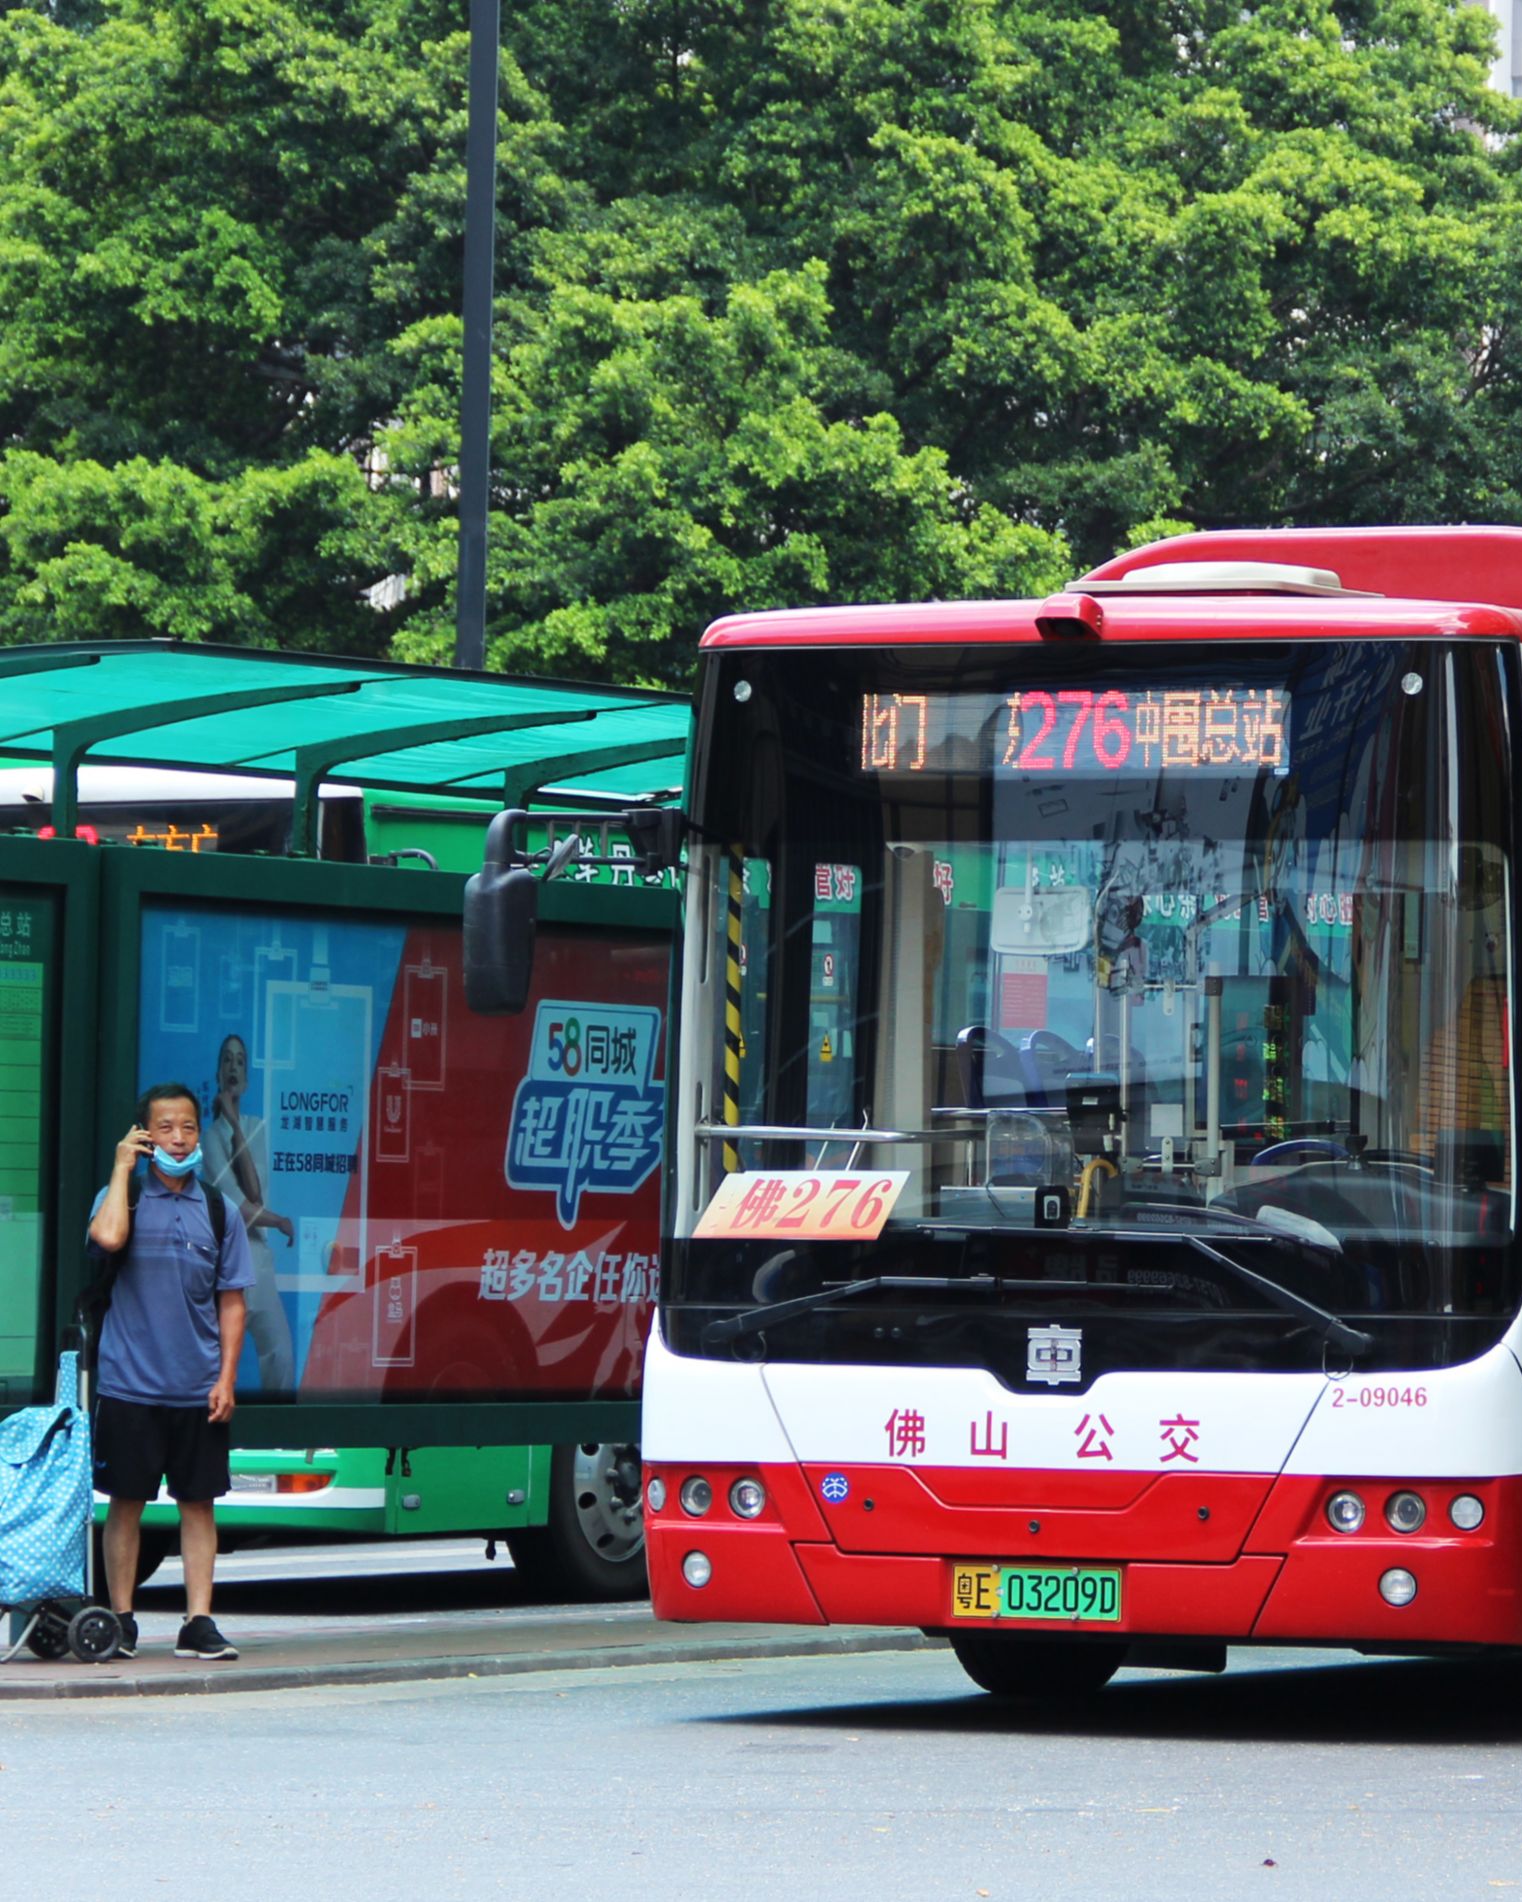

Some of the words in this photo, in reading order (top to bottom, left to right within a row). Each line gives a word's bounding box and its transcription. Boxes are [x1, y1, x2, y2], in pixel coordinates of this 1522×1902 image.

[1018, 690, 1132, 770] 276
[547, 1017, 637, 1077] 58同城
[281, 1091, 349, 1113] LONGFOR
[730, 1178, 894, 1230] 佛276
[1331, 1387, 1428, 1408] 2-09046
[884, 1408, 1201, 1463] 佛山公交
